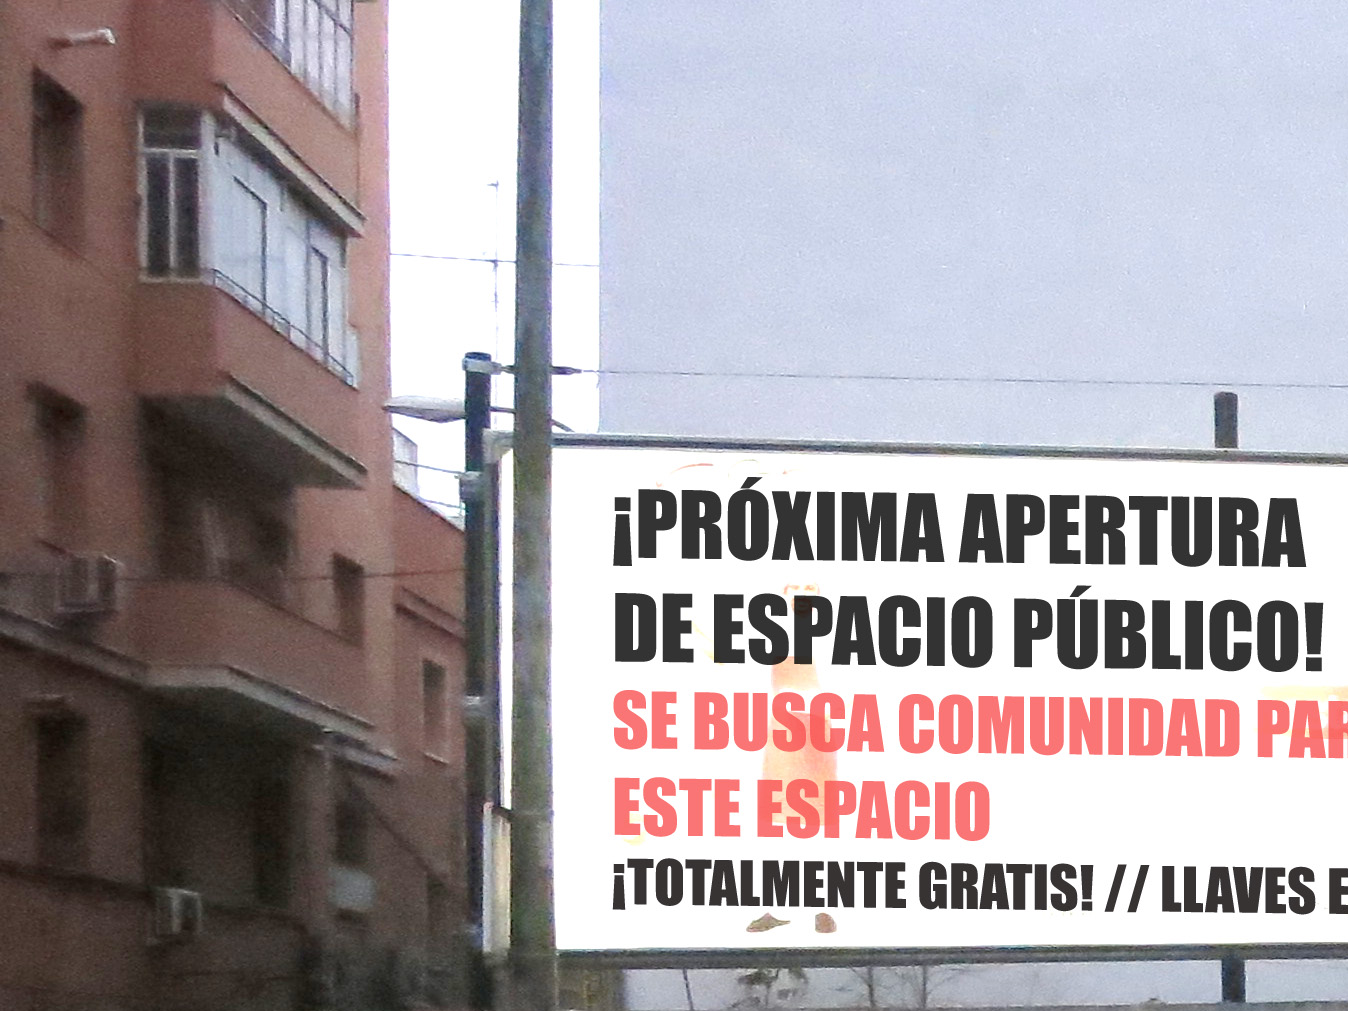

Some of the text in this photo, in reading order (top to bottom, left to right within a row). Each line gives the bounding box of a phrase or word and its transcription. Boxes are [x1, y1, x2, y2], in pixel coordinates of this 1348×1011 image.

[613, 477, 1306, 567] ¡PRÓXIMA APERTURA
[615, 586, 1323, 672] DE ESPACIO PÚBLICO!
[614, 690, 677, 749] SE
[695, 693, 884, 752] BUSCA
[899, 694, 1239, 756] COMUNIDAD
[615, 778, 989, 841] ESTE ESPACIO
[613, 858, 906, 910] ¡TOTALMENTE
[919, 862, 1093, 911] GRATIS!
[1162, 866, 1315, 914] LLAVES
